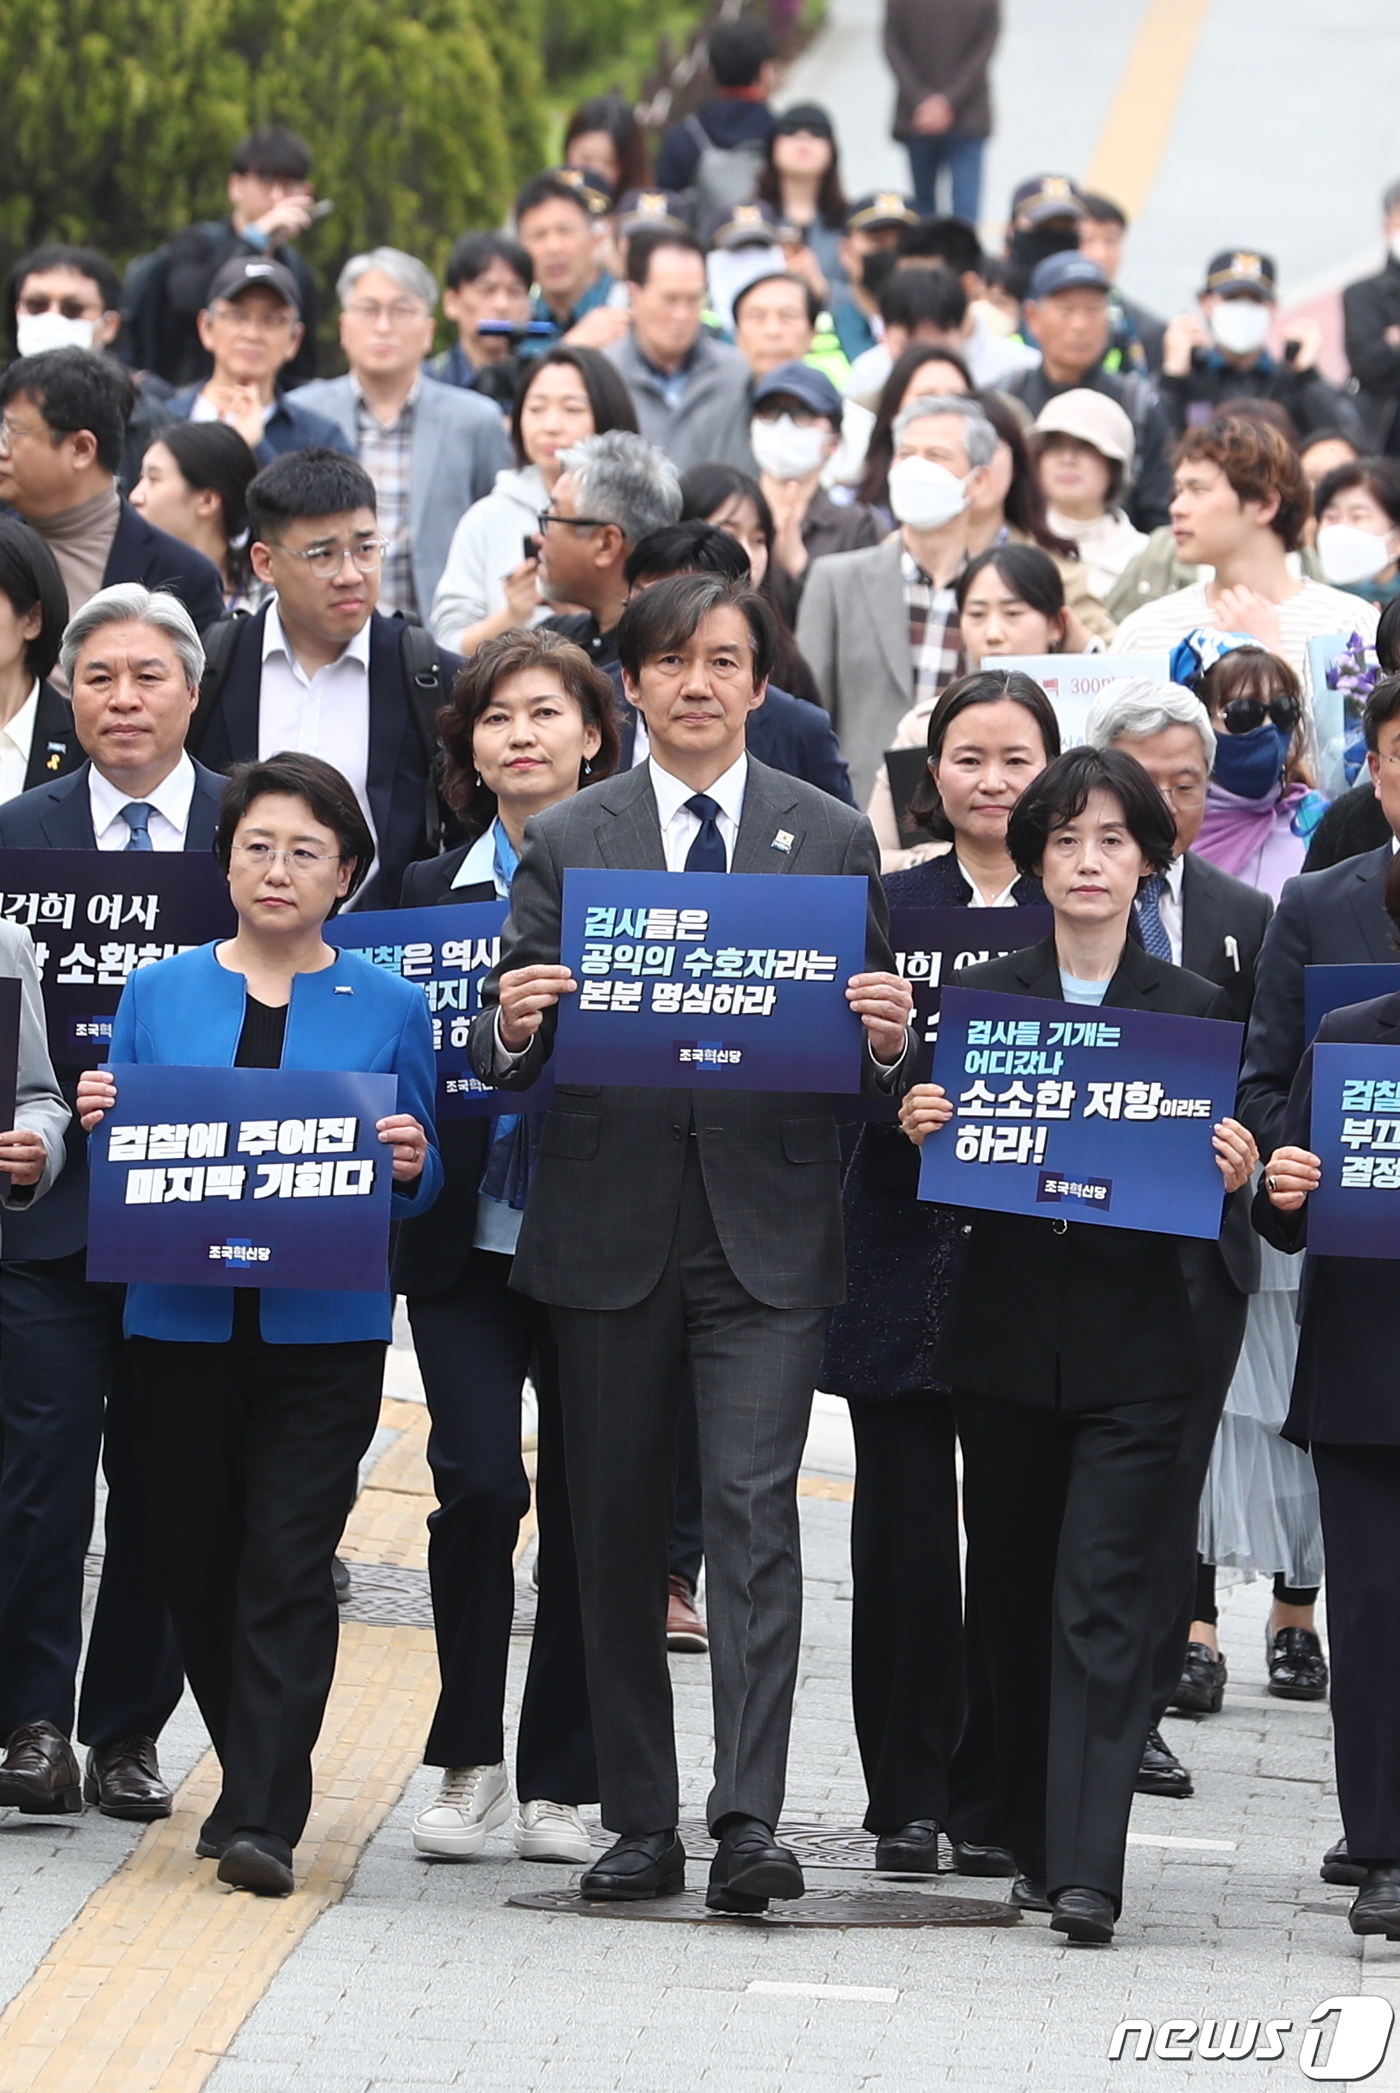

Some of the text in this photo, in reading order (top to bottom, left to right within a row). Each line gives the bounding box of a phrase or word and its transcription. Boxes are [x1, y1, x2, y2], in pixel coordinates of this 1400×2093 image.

[0, 891, 160, 931] 건희 여사
[584, 906, 710, 941] 검사들은
[580, 943, 838, 981] 공익의 수호자라는
[579, 979, 776, 1016] 본분 명심하라
[967, 1020, 1041, 1046] 검사들
[1046, 1022, 1121, 1047] 기개는
[678, 1048, 742, 1064] 조국혁신당
[964, 1050, 1064, 1076] 어디갔나
[957, 1079, 1212, 1121] 소소한 저항이라도
[108, 1117, 357, 1161] 검찰에 주어진
[955, 1124, 1048, 1164] 하라!
[125, 1159, 374, 1204] 마지막 기회다
[1044, 1179, 1107, 1200] 조국혁신당
[1341, 1156, 1400, 1189] 결정
[208, 1245, 271, 1262] 조국혁신당
